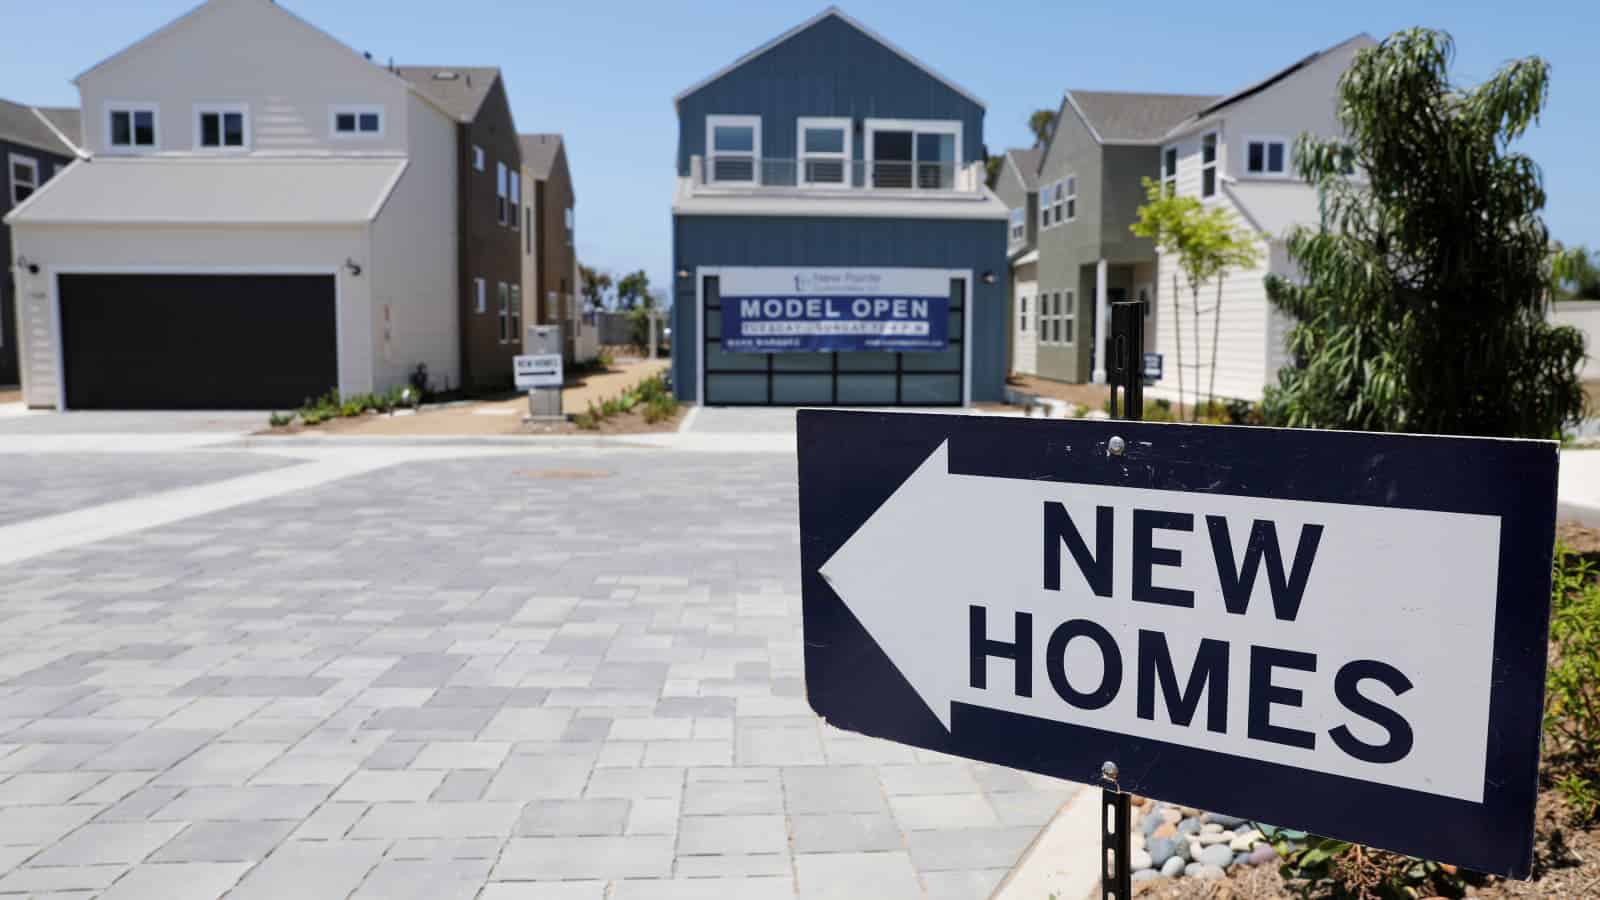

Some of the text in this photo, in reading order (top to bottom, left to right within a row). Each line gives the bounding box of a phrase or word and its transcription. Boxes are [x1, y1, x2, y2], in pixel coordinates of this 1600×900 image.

[740, 298, 930, 319] MODEL OPEN
[1043, 500, 1325, 622] NEW
[968, 604, 1415, 764] HOMES
